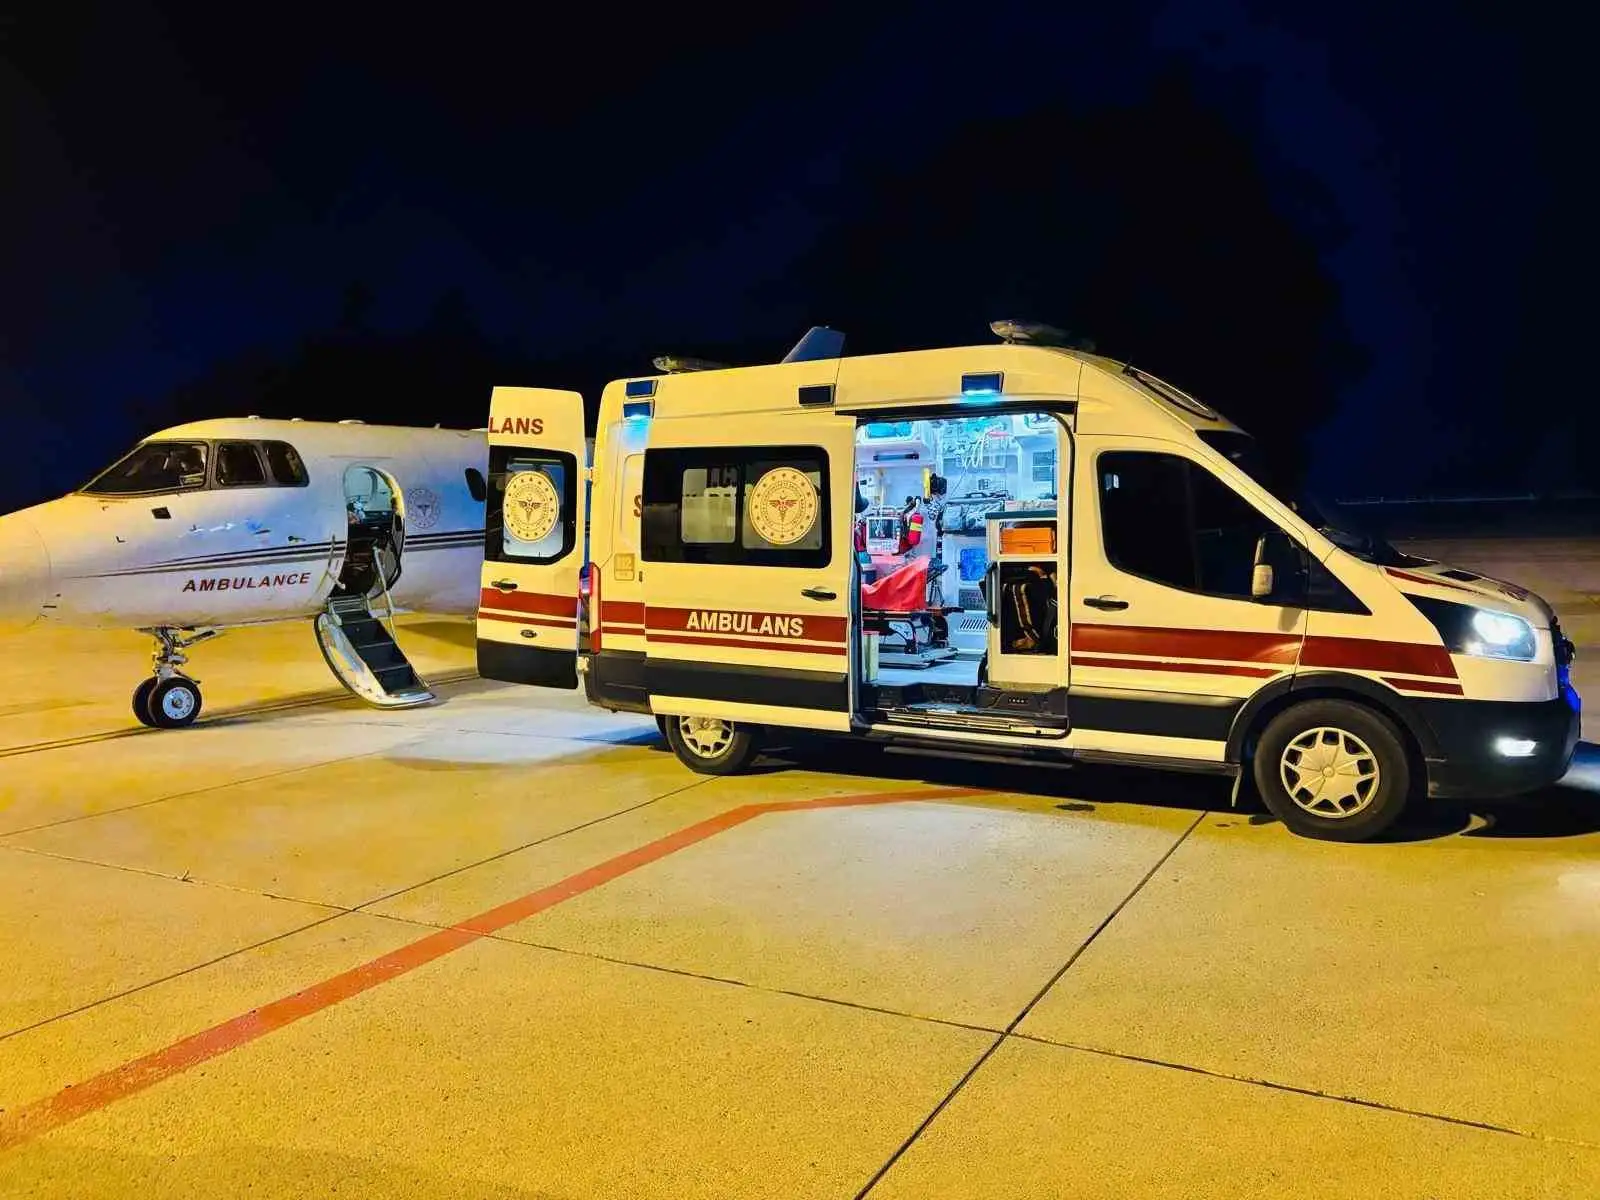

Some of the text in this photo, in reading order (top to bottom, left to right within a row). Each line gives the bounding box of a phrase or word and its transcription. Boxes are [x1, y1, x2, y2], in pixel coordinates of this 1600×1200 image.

[488, 416, 544, 435] LANS
[182, 572, 311, 592] AMBULANCE
[686, 611, 804, 637] AMBULANS
